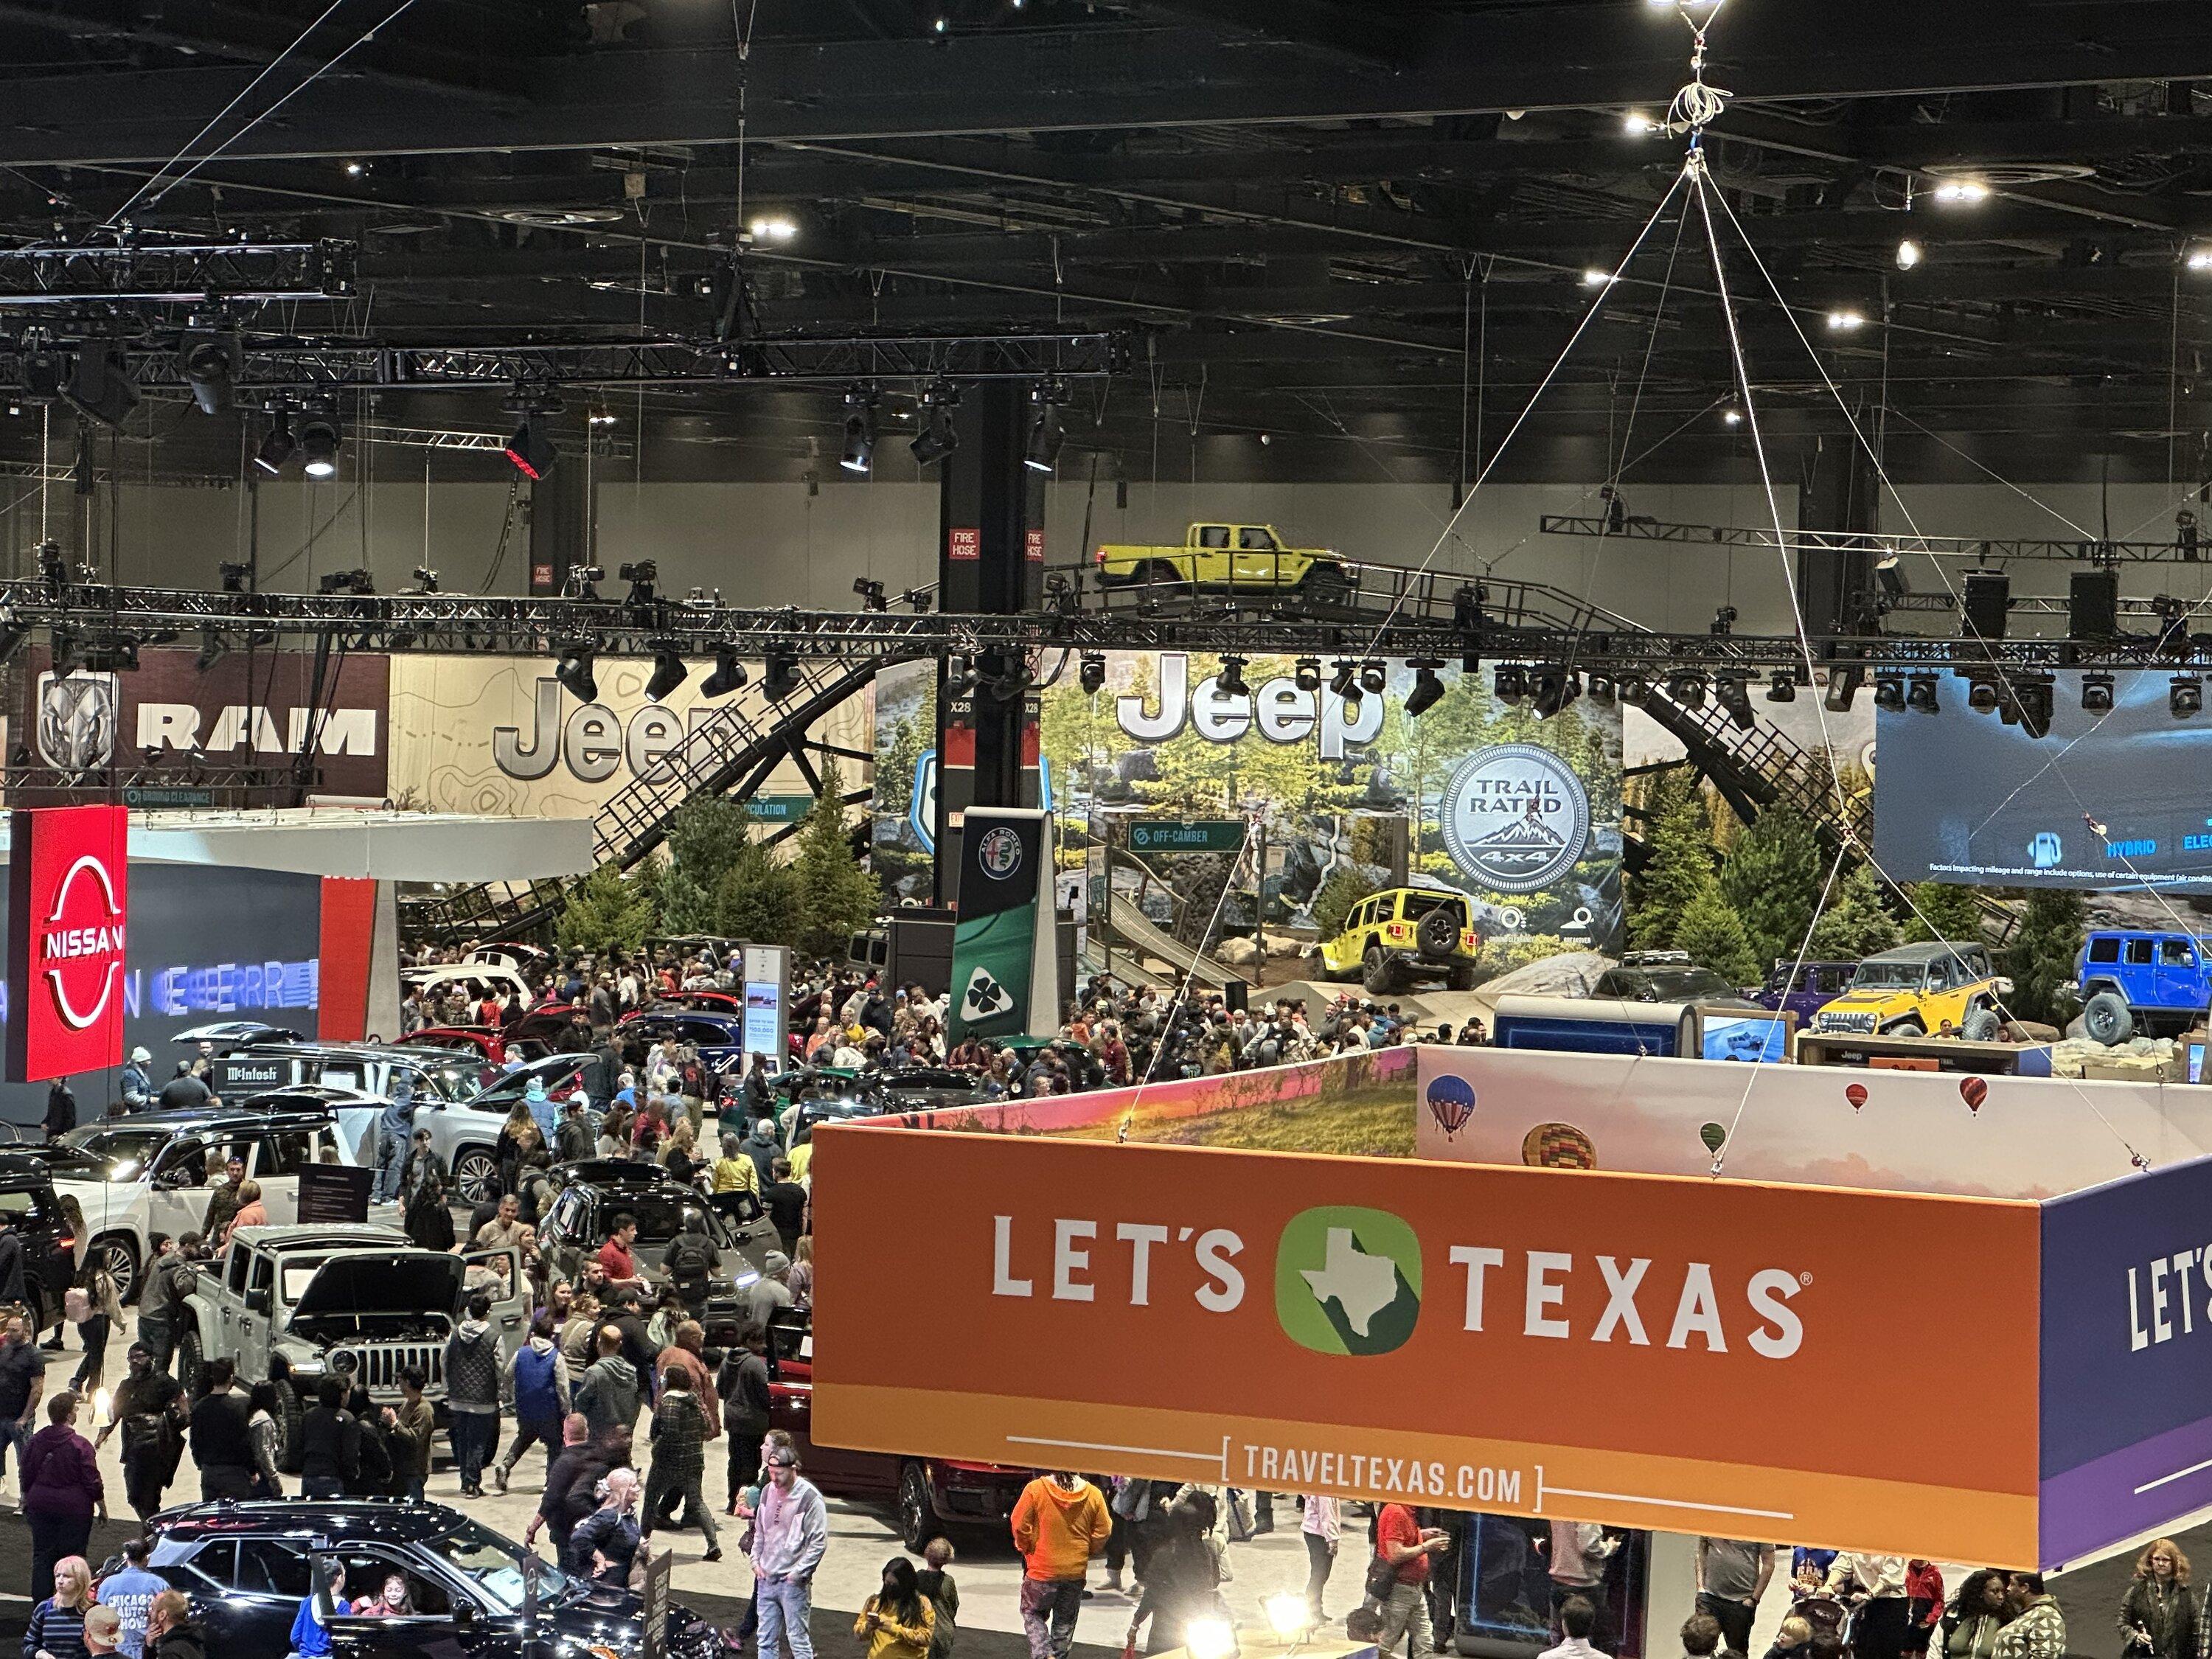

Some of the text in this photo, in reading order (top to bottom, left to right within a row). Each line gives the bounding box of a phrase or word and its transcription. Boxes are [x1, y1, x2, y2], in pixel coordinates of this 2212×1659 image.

[954, 532, 975, 543] FIRE
[1028, 533, 1041, 544] FIRE
[953, 545, 976, 555] HOSE
[1027, 546, 1042, 557] HOSE
[950, 702, 972, 713] X28
[1024, 703, 1039, 714] X28
[136, 703, 377, 757] RAM
[1476, 780, 1559, 794] TRAIL
[950, 813, 964, 823] EXIT
[999, 830, 1020, 855] ROMEO
[1153, 830, 1208, 843] OFF-CAMBER
[2107, 839, 2157, 858] HYBRID
[1480, 851, 1550, 863] 4x4
[1929, 863, 1952, 872] Factors
[1952, 864, 1985, 874] impacting
[1985, 866, 2011, 875] mileage
[2011, 867, 2024, 875] and
[2024, 869, 2043, 877] range
[2043, 869, 2067, 877] include
[2067, 870, 2095, 879] options,
[2115, 872, 2138, 880] certain
[2138, 873, 2175, 882] equipment
[46, 925, 123, 959] NISSAN
[1841, 1051, 1863, 1061] Jeep
[227, 1066, 277, 1081] McIntosh
[992, 1215, 1245, 1313] LET'S
[1244, 1445, 1521, 1504] TRAVELTEXAS.COM
[773, 1504, 782, 1526] NIKE
[118, 1617, 149, 1630] HOW
